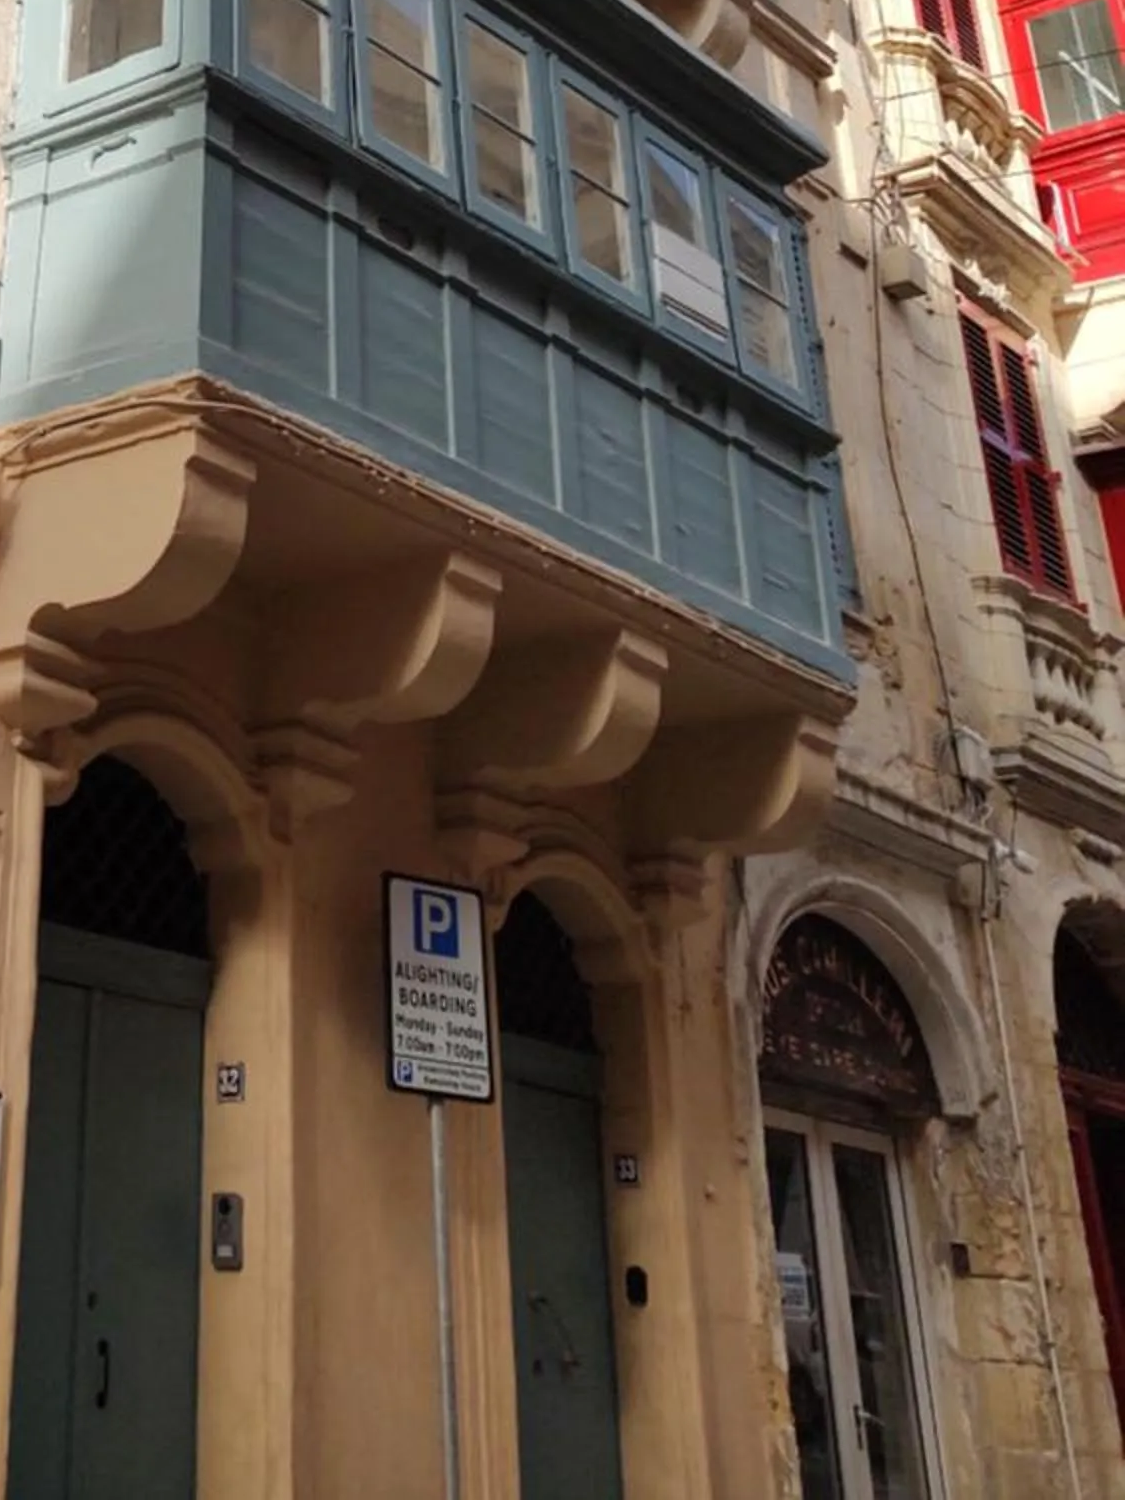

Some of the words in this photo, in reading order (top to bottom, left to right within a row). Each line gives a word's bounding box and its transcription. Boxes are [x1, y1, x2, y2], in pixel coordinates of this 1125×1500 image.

[421, 894, 453, 950] P
[395, 961, 479, 994] ALIGHTING/
[398, 986, 477, 1018] BOARDING
[395, 1013, 436, 1036] Monday
[446, 1021, 484, 1044] Sunday
